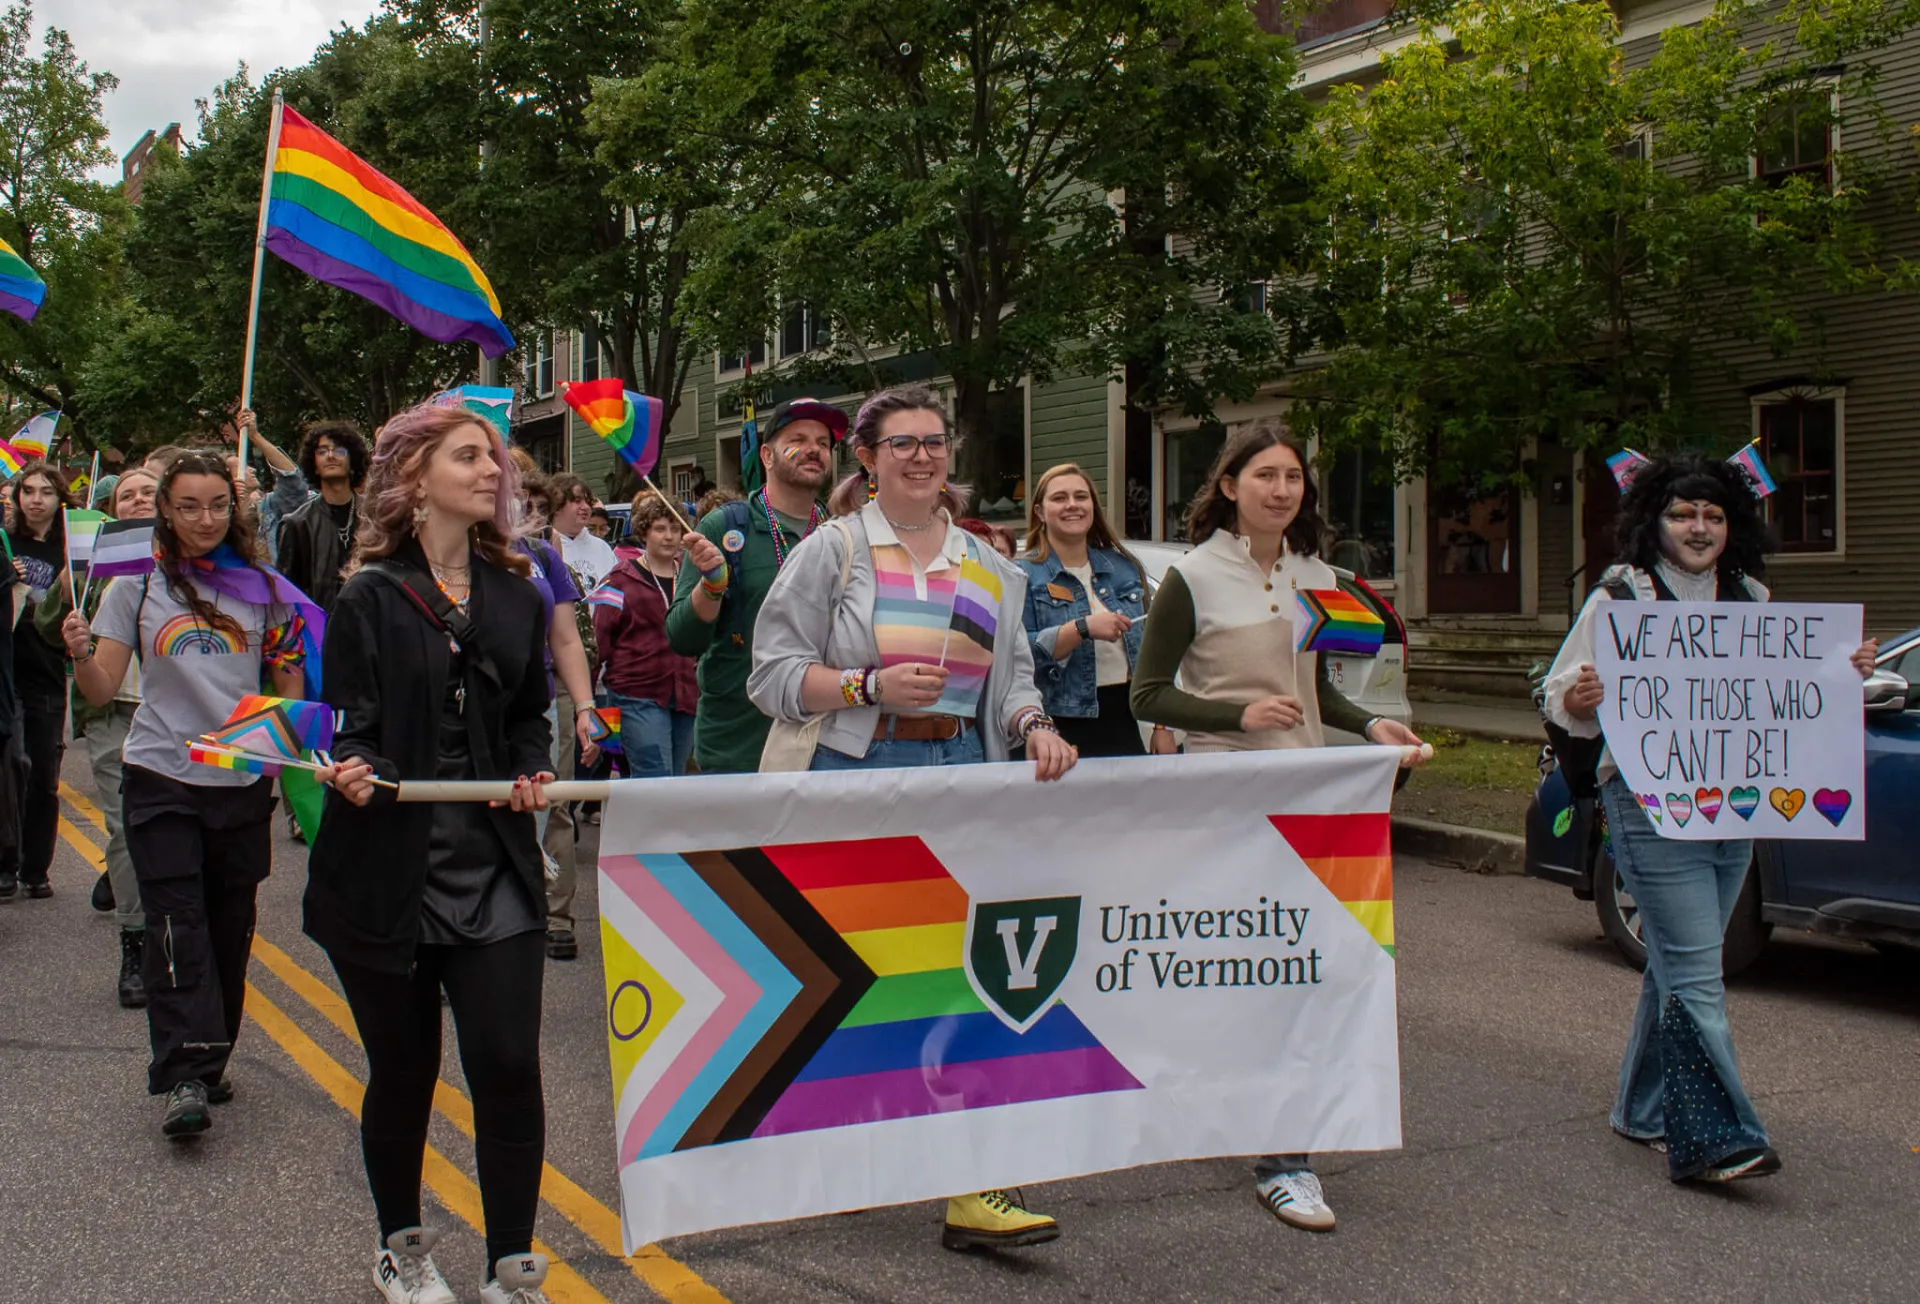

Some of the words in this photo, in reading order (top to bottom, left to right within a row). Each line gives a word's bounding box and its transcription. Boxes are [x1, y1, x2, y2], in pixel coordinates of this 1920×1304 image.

[1607, 612, 1658, 661] WE
[1666, 614, 1729, 659] ARE
[1739, 614, 1824, 660] HERE
[1618, 675, 1673, 721] FOR
[1684, 677, 1756, 721] THOSE
[1765, 678, 1823, 720] WHO
[1640, 728, 1733, 783] CAN'T
[1745, 728, 1789, 779] BE!
[1099, 896, 1310, 946] University
[996, 915, 1057, 990] V
[1095, 948, 1138, 993] of
[1147, 948, 1323, 989] Vermont
